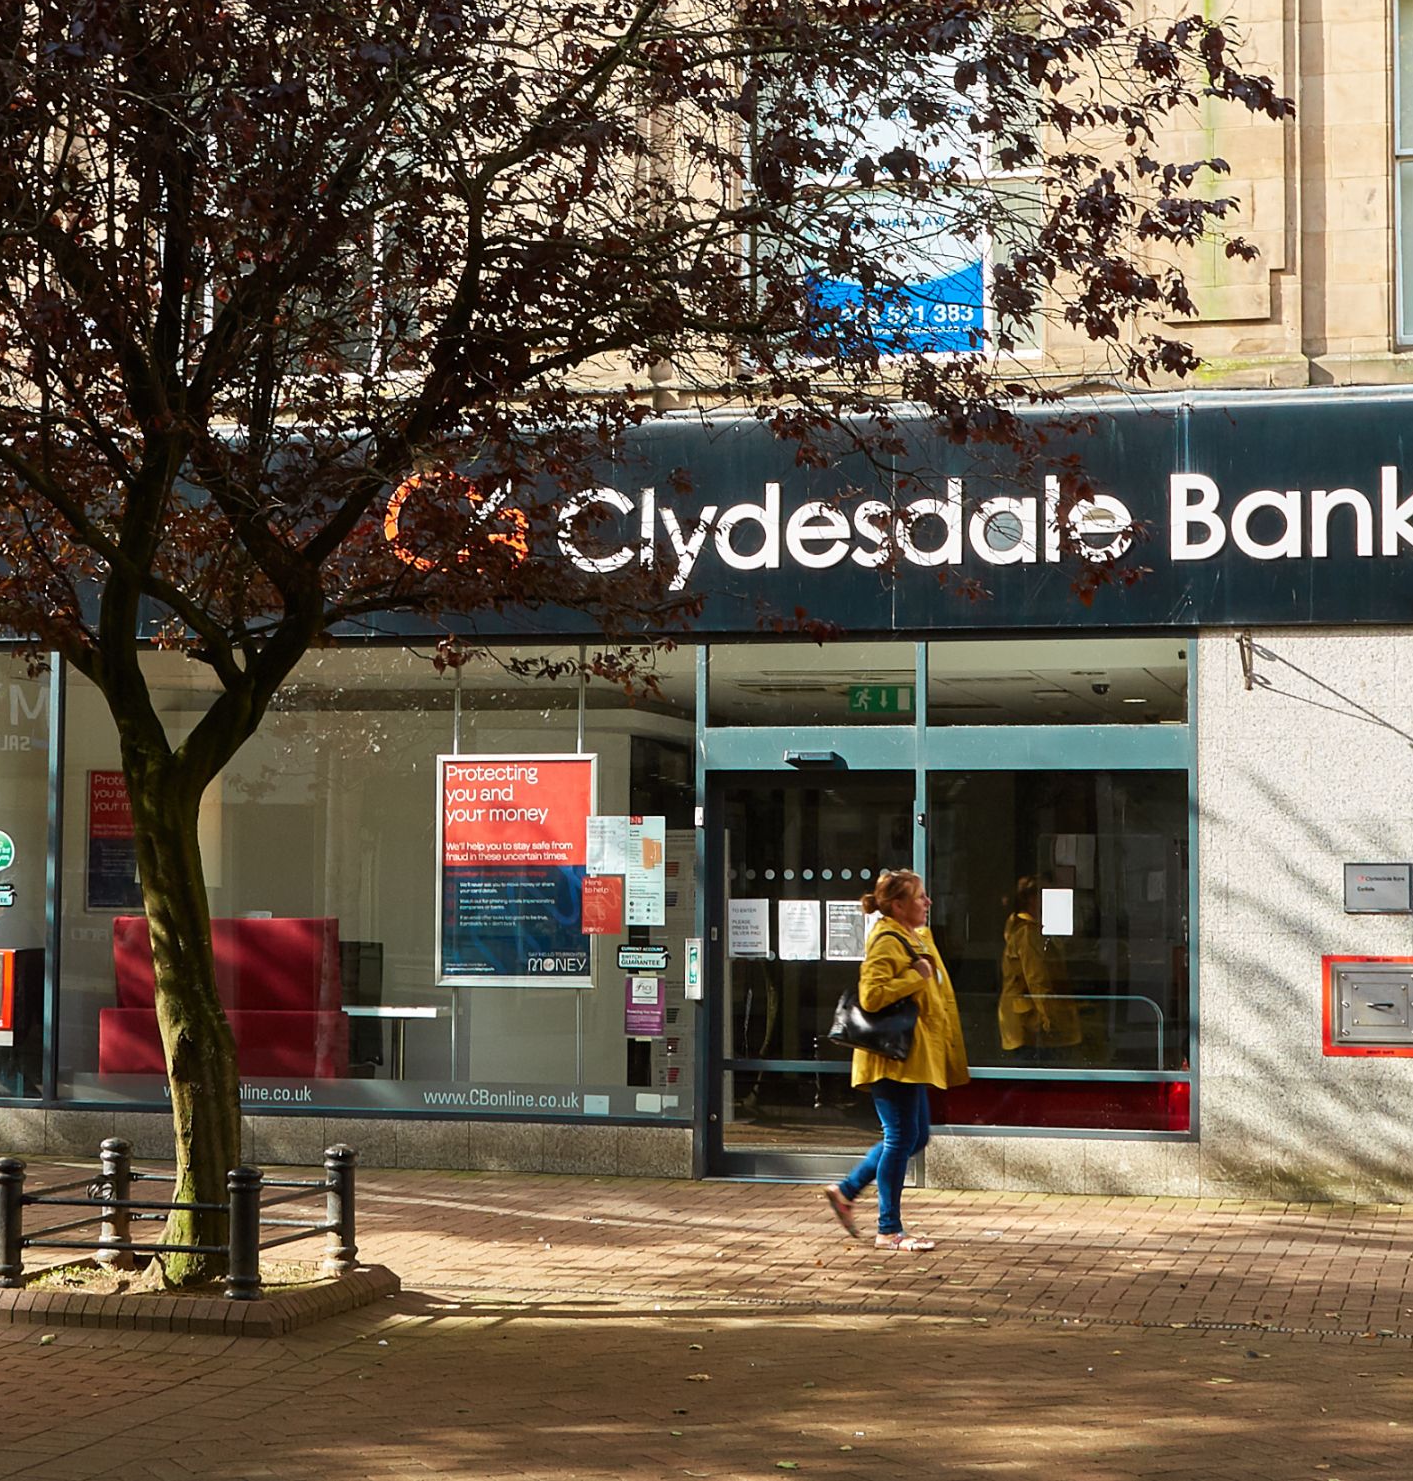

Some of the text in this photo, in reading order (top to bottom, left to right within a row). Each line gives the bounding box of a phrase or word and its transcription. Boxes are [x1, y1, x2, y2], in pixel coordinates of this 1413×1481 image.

[933, 304, 974, 323] 383
[557, 473, 1134, 593] Clydesdale
[446, 764, 539, 785] Protecting
[445, 783, 514, 806] you and
[445, 807, 549, 826] your money
[446, 840, 573, 853] We'll help you to stay safe from
[446, 850, 568, 861] fraud in these uncertain times.
[585, 879, 602, 887] Here
[585, 885, 610, 895] to help
[527, 958, 588, 972] MONEY
[621, 959, 661, 967] GUARANTEE
[423, 1088, 580, 1110] www.CBonline.co.uk
